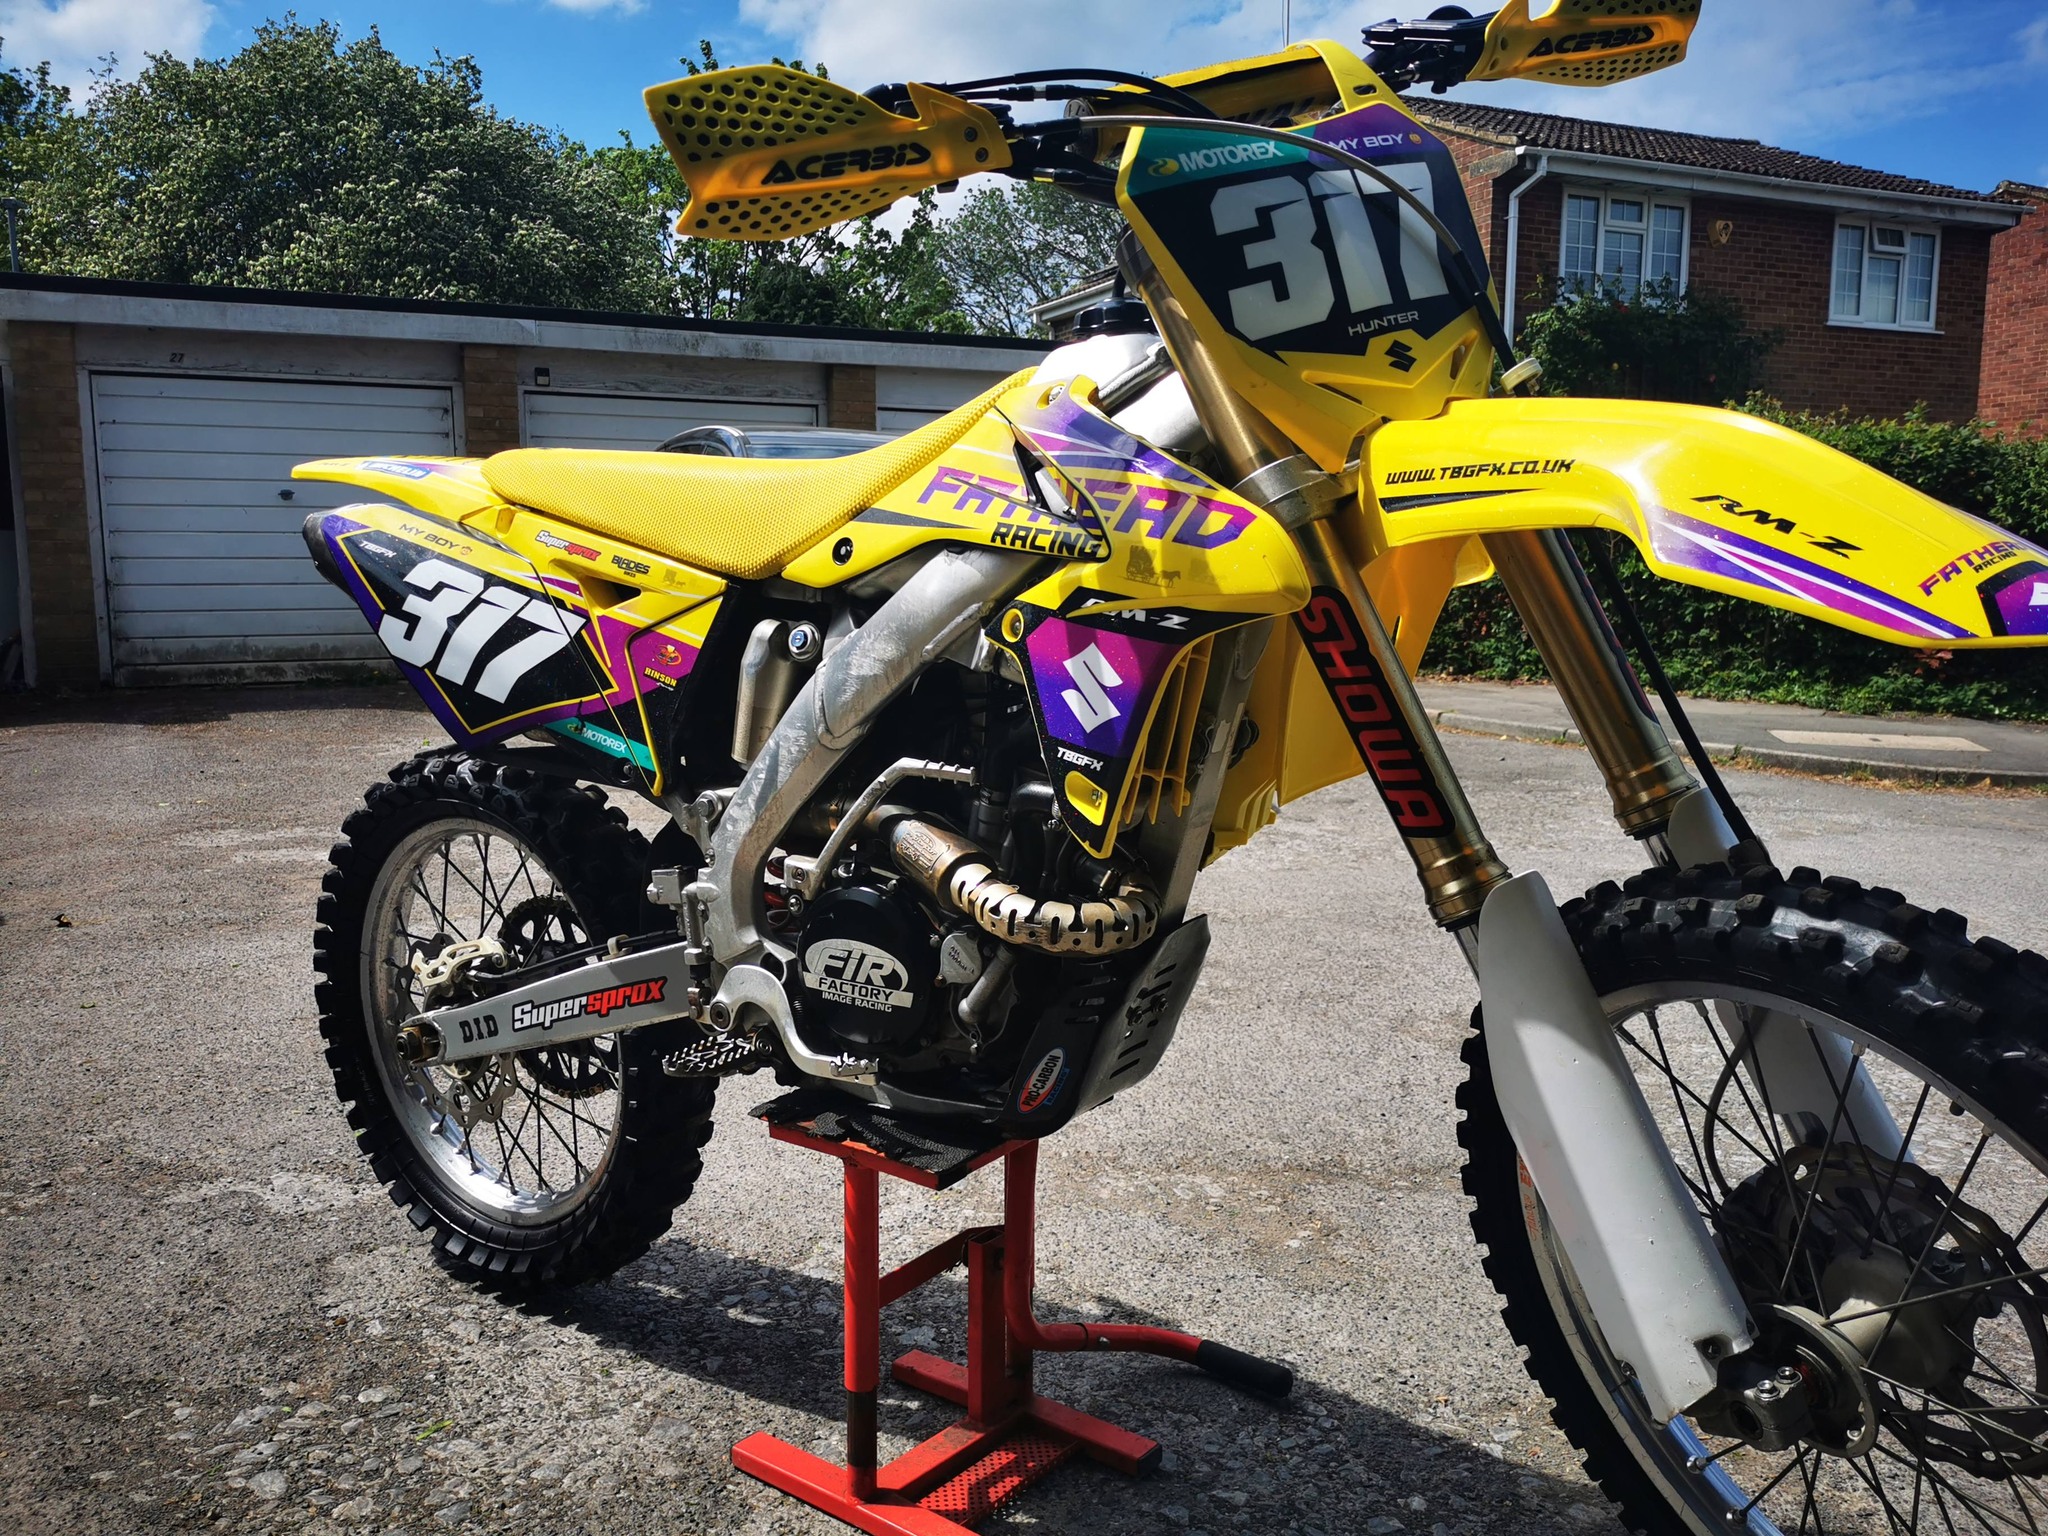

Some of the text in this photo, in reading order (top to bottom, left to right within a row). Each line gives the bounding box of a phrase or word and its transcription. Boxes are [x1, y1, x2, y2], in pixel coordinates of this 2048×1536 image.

[1329, 133, 1403, 151] MY BOY
[1178, 141, 1284, 172] MOTOREX
[1210, 161, 1449, 342] 317
[1348, 310, 1420, 337] HUNTER
[169, 352, 185, 363] 27
[1385, 459, 1576, 485] WWW.TBGFX.CO.UK
[399, 523, 460, 551] MY BOY
[990, 521, 1105, 559] RACING
[1691, 495, 1864, 560] RM-Z
[536, 530, 601, 560] Supersprox
[611, 554, 651, 576] BLADES
[379, 558, 588, 704] 317
[1298, 596, 1444, 827] SHOWA
[582, 727, 627, 754] MOTOREX
[1057, 746, 1103, 771] TBGFX
[818, 976, 893, 1002] FACTORY
[822, 991, 892, 1013] IMAGE RACING
[513, 979, 666, 1030] Supersprox
[1021, 1054, 1062, 1108] PRO-CARBON
